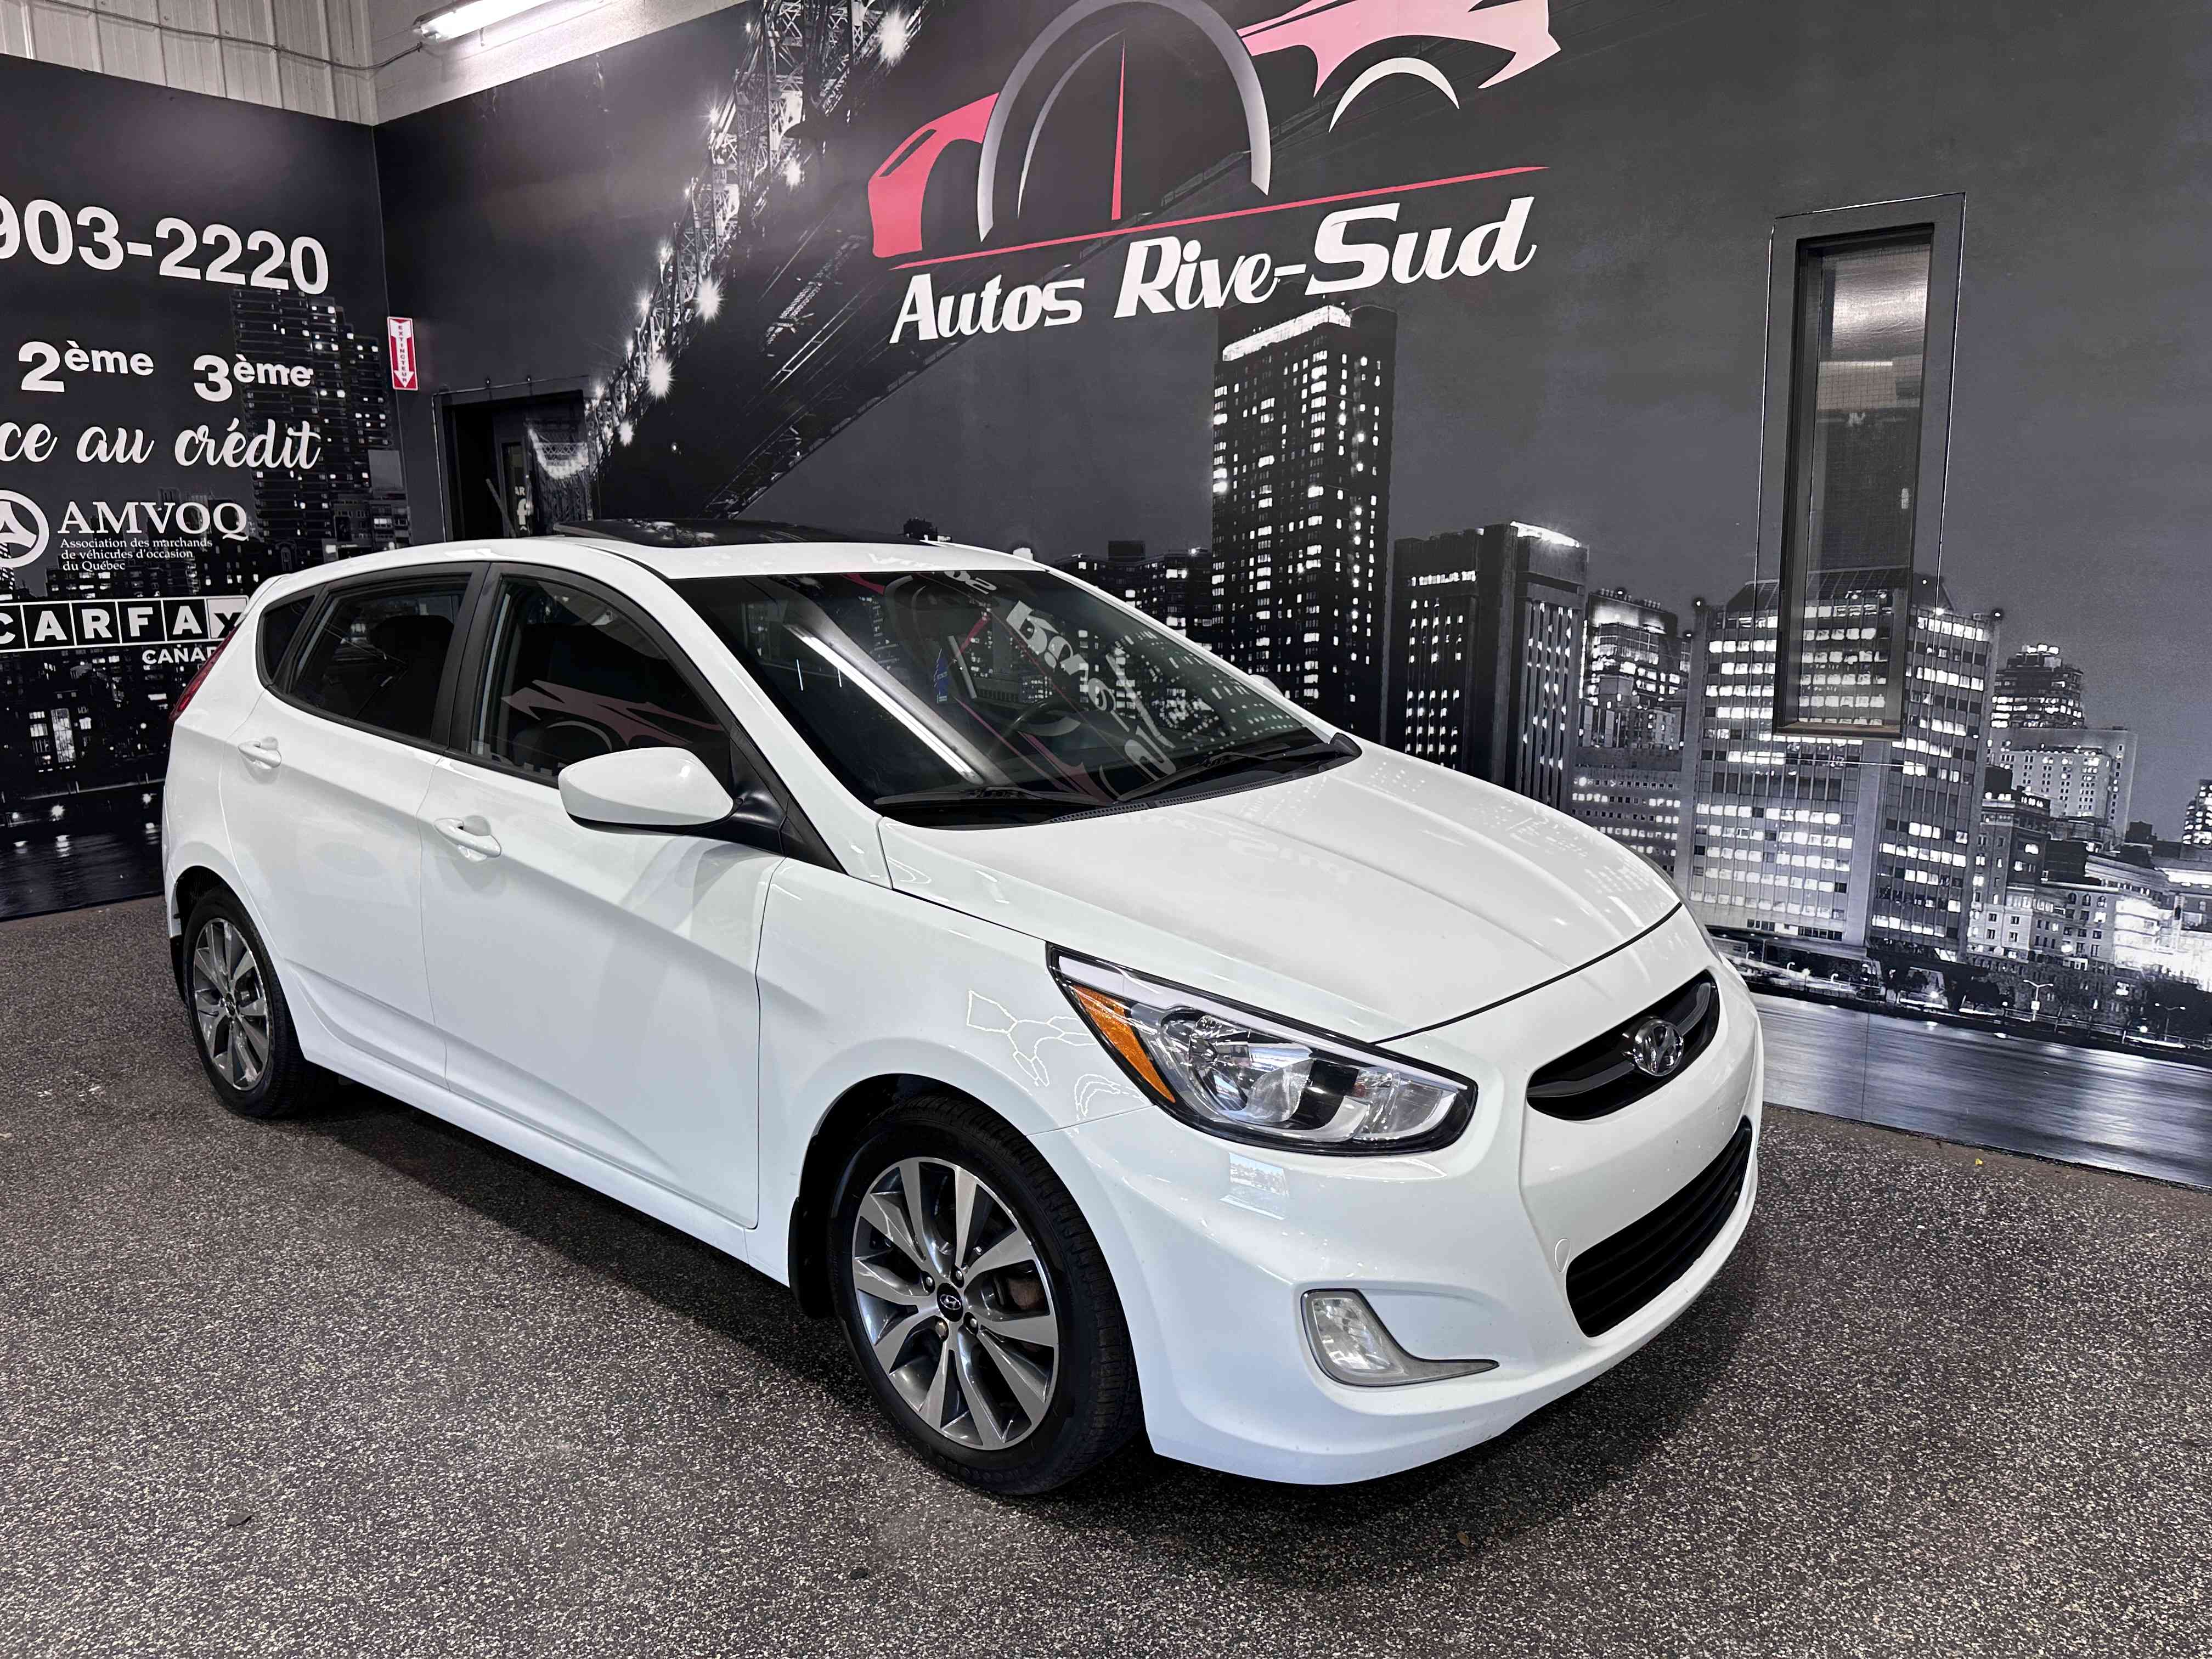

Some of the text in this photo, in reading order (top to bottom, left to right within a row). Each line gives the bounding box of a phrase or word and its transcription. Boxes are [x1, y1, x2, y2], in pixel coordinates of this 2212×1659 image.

[889, 196, 1537, 343] Autos Rive-Sud
[18, 340, 313, 402] 2ème 3ème
[398, 325, 407, 382] EXTINCTEUR
[76, 426, 155, 464] au
[174, 417, 321, 470] crédit
[57, 501, 249, 541] AMVOQ
[60, 537, 213, 548] Association des marchands
[61, 549, 193, 559] de véhicules d'occasion
[63, 561, 126, 572] du Québec
[142, 646, 217, 664] CANA
